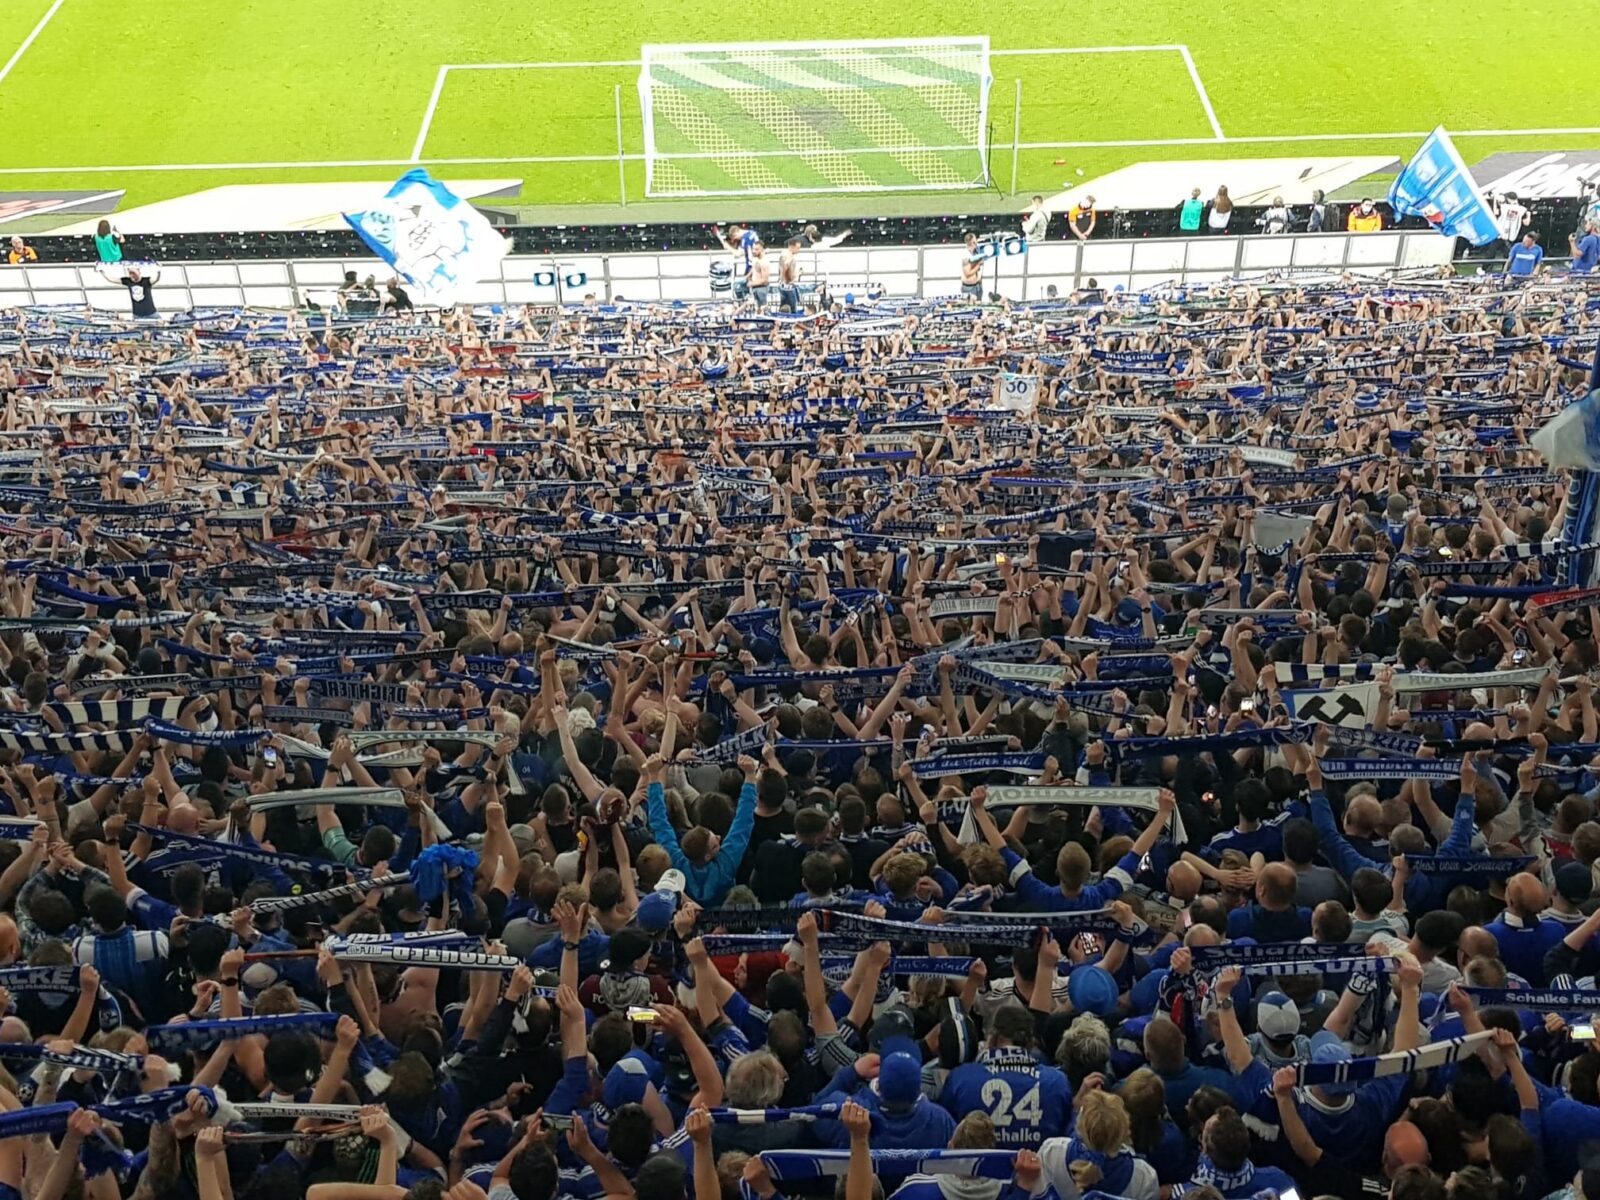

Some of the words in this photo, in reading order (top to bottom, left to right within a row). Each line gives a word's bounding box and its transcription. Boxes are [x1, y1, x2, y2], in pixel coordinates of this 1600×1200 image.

[425, 596, 499, 609] SCHALKE
[438, 659, 506, 674] Salke
[703, 727, 766, 761] CHALK
[1505, 992, 1569, 1004] Schalke
[981, 1078, 1044, 1127] 24
[994, 1127, 1042, 1142] chalke
